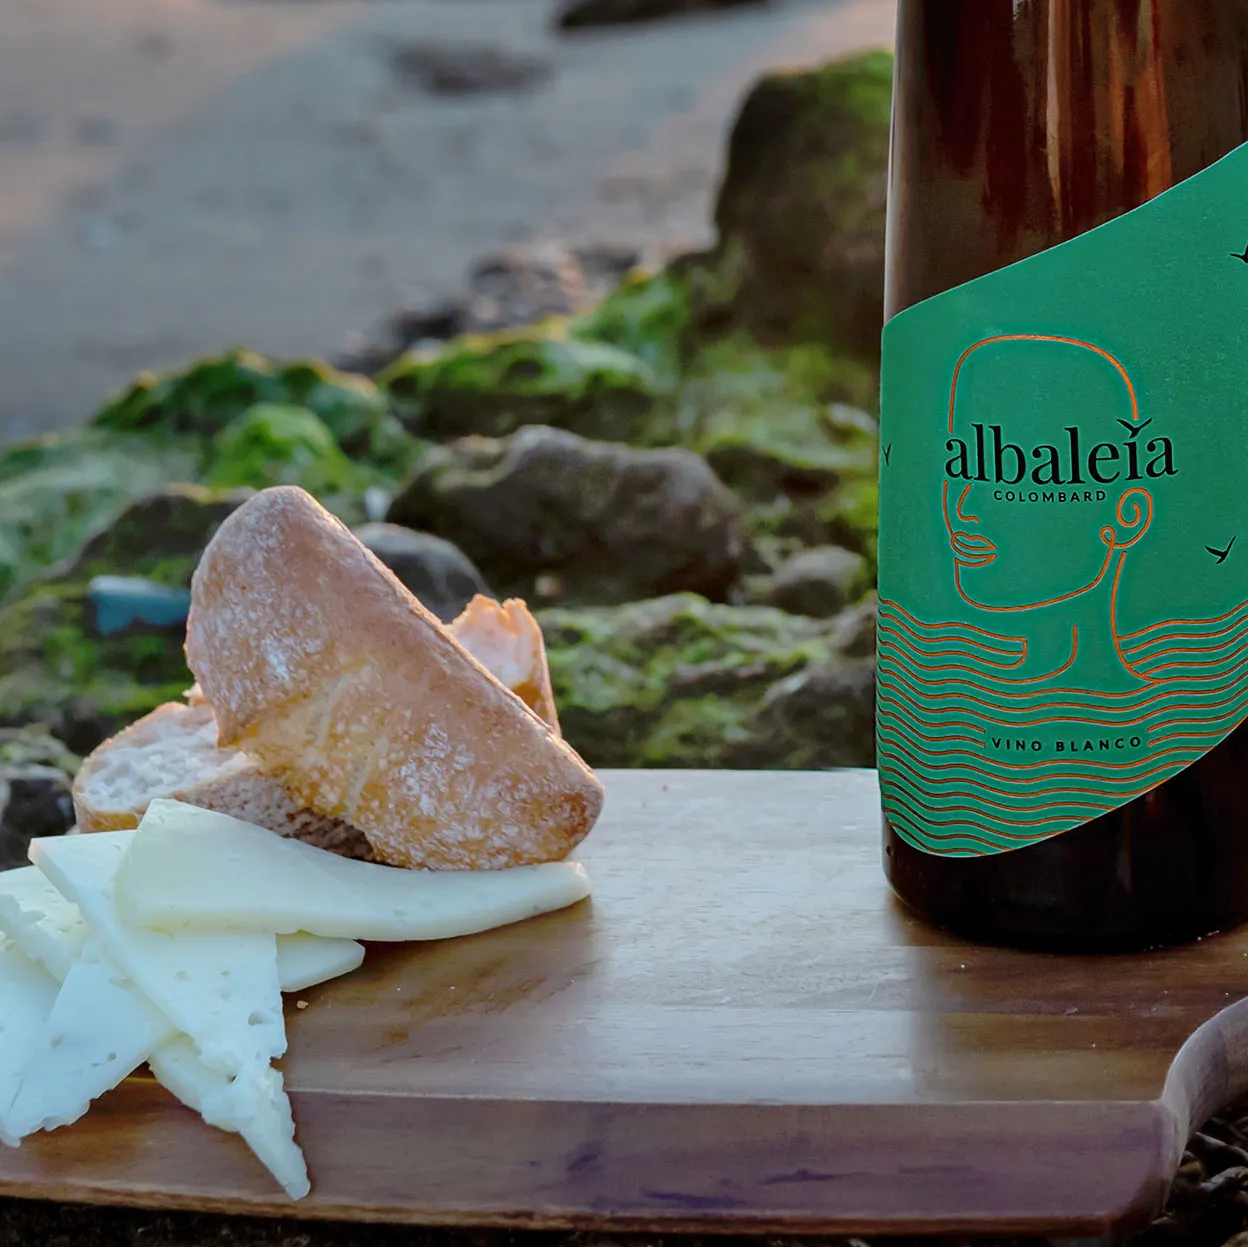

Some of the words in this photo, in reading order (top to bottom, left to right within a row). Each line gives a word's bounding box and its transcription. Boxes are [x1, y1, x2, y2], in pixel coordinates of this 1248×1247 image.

[993, 490, 1107, 503] COLOMBARD
[991, 737, 1042, 752] VINO
[1055, 736, 1141, 752] BLANCO
